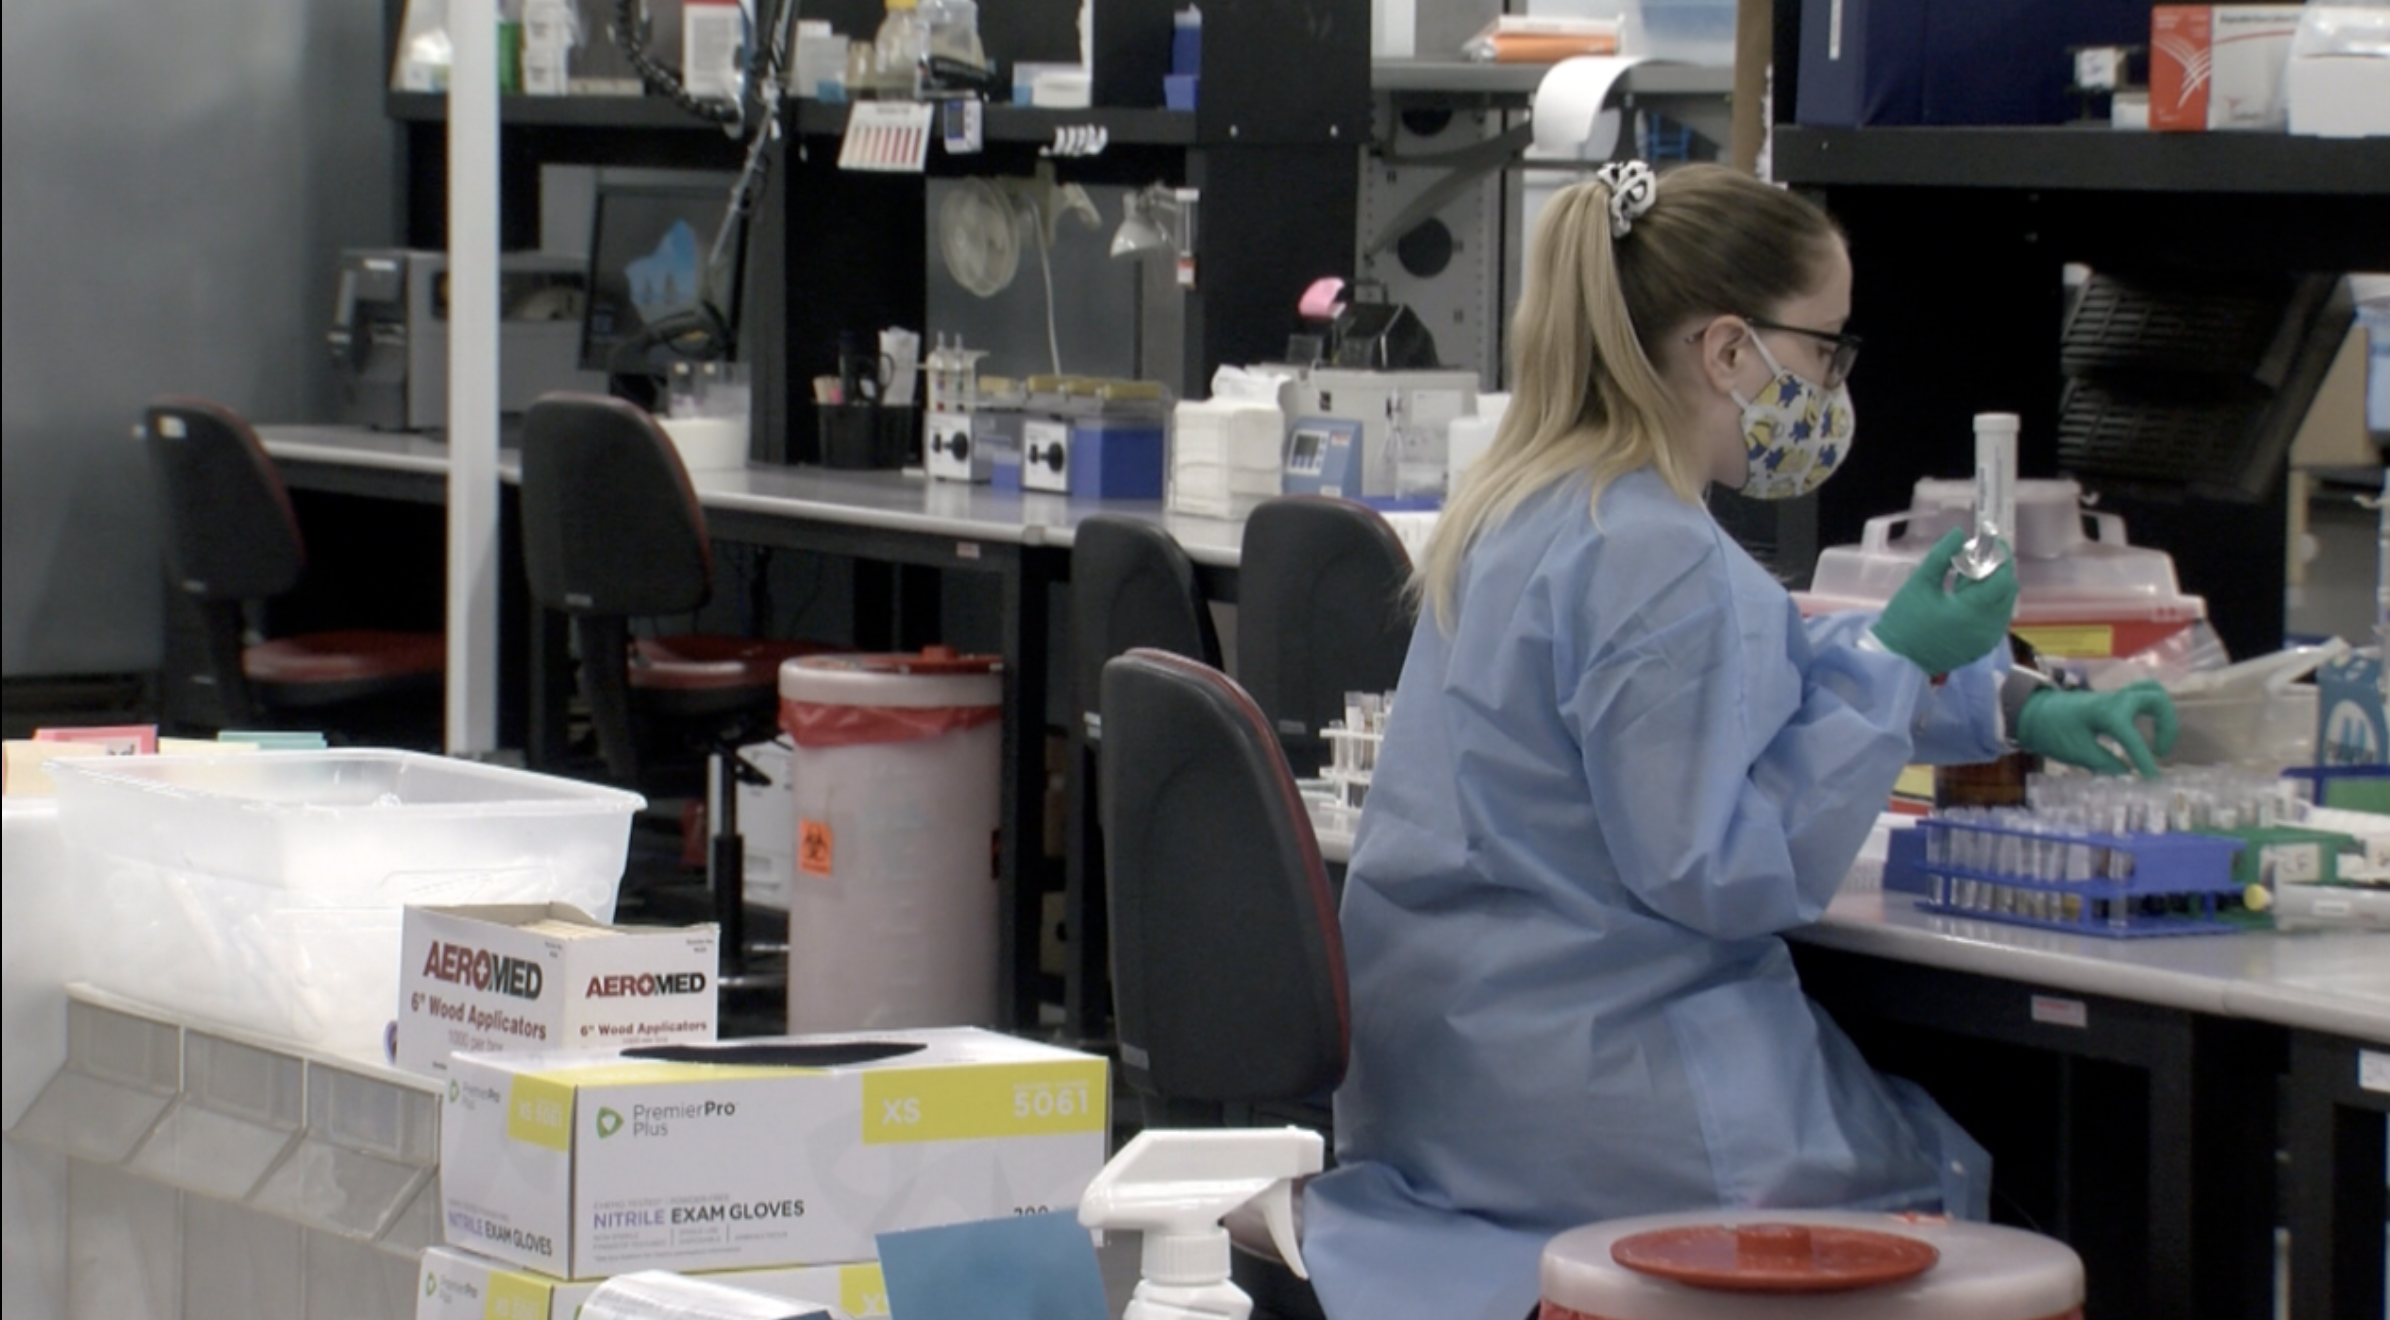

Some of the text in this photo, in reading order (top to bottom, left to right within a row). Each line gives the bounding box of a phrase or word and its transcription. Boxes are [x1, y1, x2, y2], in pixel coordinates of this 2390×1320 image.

[423, 940, 542, 1001] AEROMED
[586, 973, 706, 998] AEROMED
[411, 992, 547, 1041] 6" Wood Applicators
[580, 1020, 707, 1037] 6" Wood Applicators
[633, 1100, 735, 1121] PremierPro
[882, 1097, 921, 1126] XS
[1013, 1088, 1088, 1119] 5061
[633, 1120, 669, 1137] Plus
[594, 1208, 665, 1230] NITRILE
[671, 1205, 725, 1225] EXAM
[729, 1198, 805, 1220] GLOVES
[484, 1220, 512, 1244] EXAM
[513, 1228, 552, 1257] GLOVES
